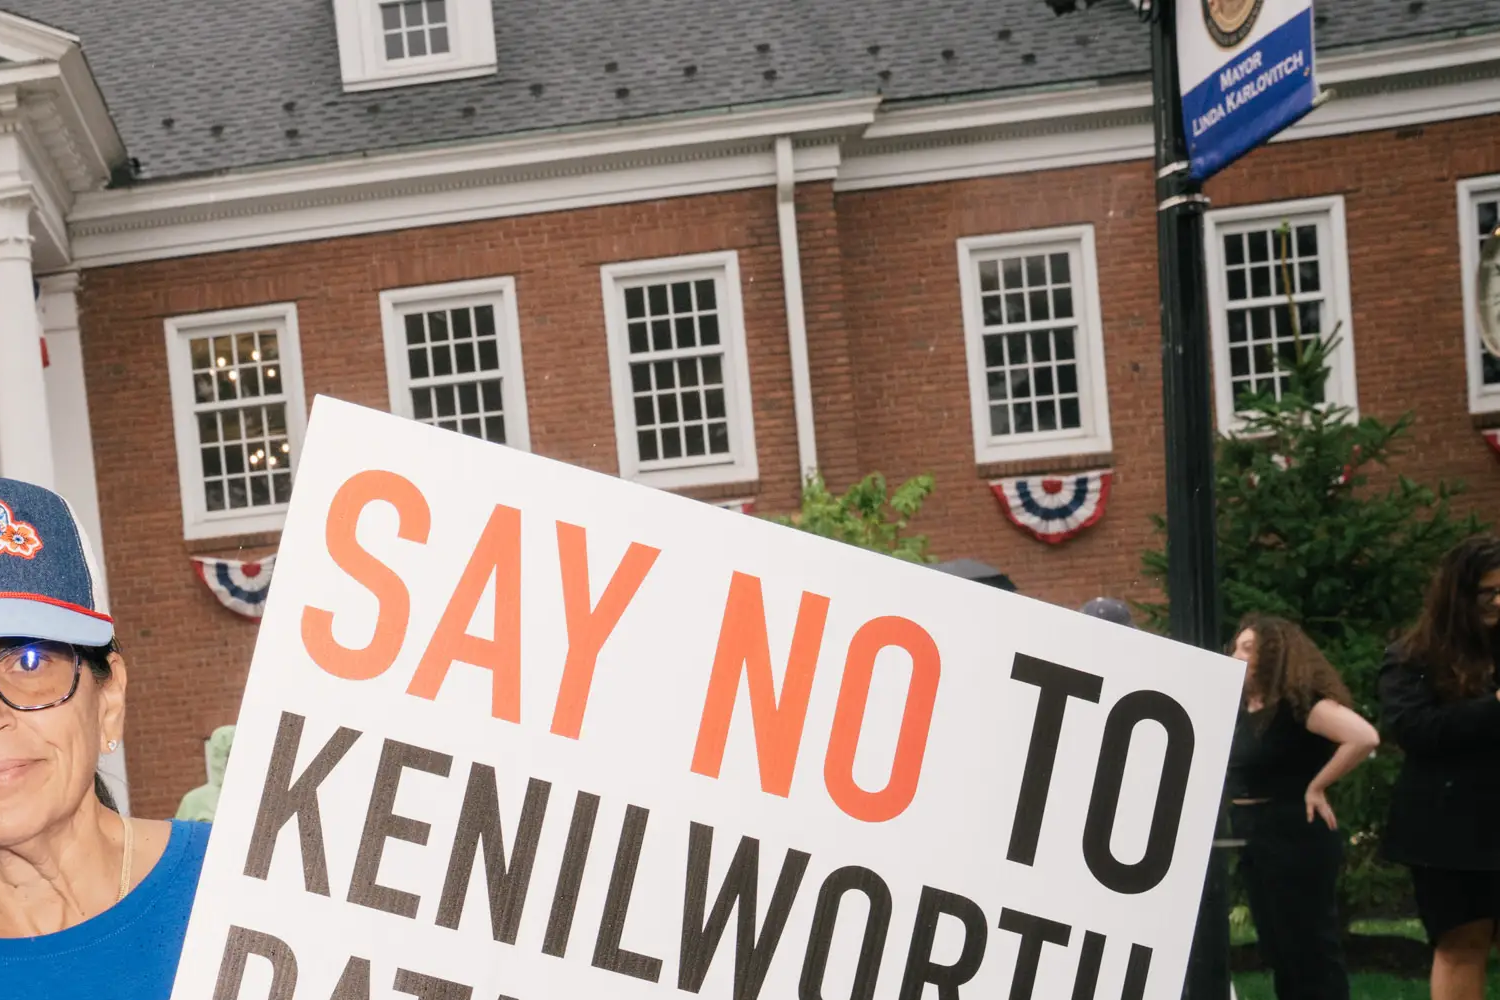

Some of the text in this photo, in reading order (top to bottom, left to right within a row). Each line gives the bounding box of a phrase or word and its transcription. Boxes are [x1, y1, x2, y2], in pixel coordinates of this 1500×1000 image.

[1191, 50, 1304, 137] LINDA KARLOVITCH
[1219, 50, 1263, 92] MAYOR
[300, 468, 1196, 895] SAY NO TO
